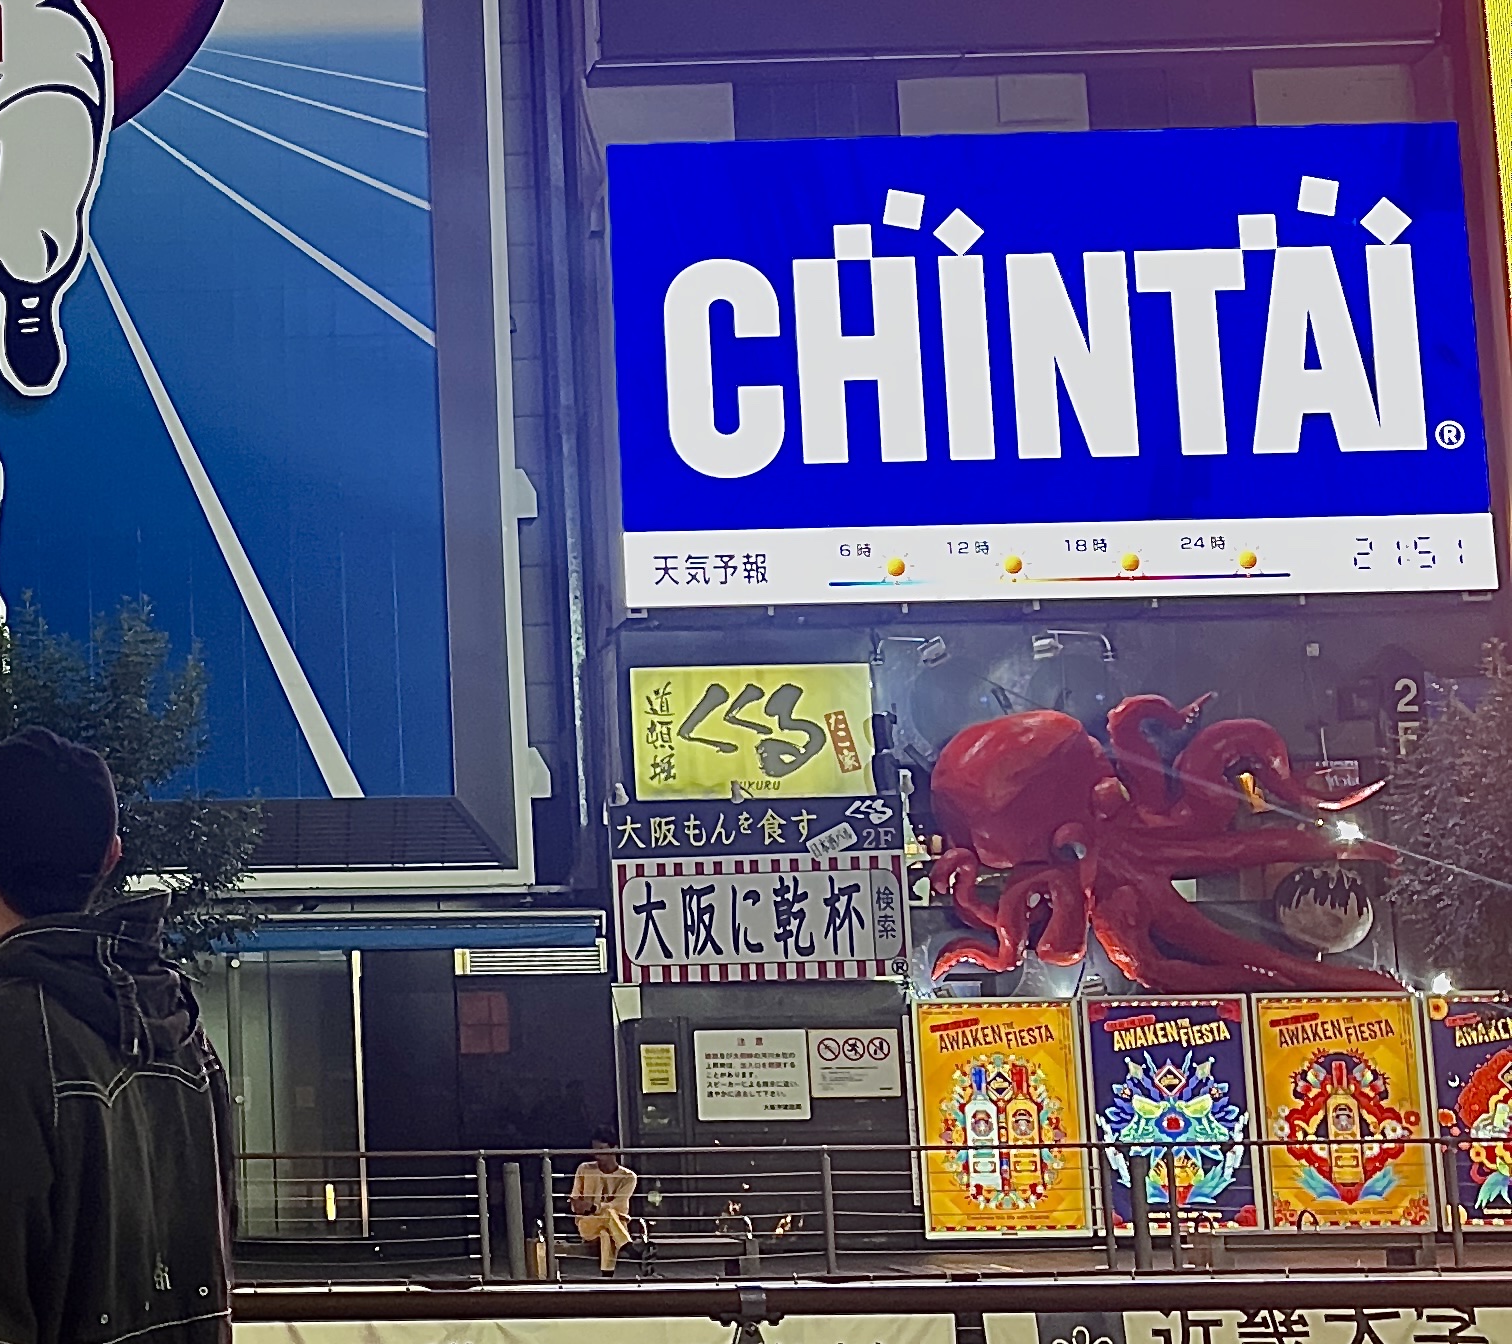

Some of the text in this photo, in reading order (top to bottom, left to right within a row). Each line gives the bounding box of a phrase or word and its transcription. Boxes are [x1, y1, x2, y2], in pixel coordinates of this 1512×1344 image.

[663, 174, 1429, 480] CHINTAI
[654, 553, 768, 585] 天気予報
[644, 681, 677, 784] 道頓堀
[676, 683, 827, 779] くくる
[732, 780, 781, 792] UKURU
[616, 808, 817, 849] 大阪もんを食す
[862, 827, 896, 849] 2F
[632, 874, 897, 960] 大阪に乾杯 検索
[938, 1024, 1003, 1053] AWAKEN
[1005, 1024, 1054, 1049] FIESTA
[1113, 1020, 1179, 1051] AWAKEN
[1181, 1020, 1230, 1047] FIESTA
[1278, 1019, 1343, 1048] AWAKEN
[1345, 1020, 1395, 1044] FIESTA
